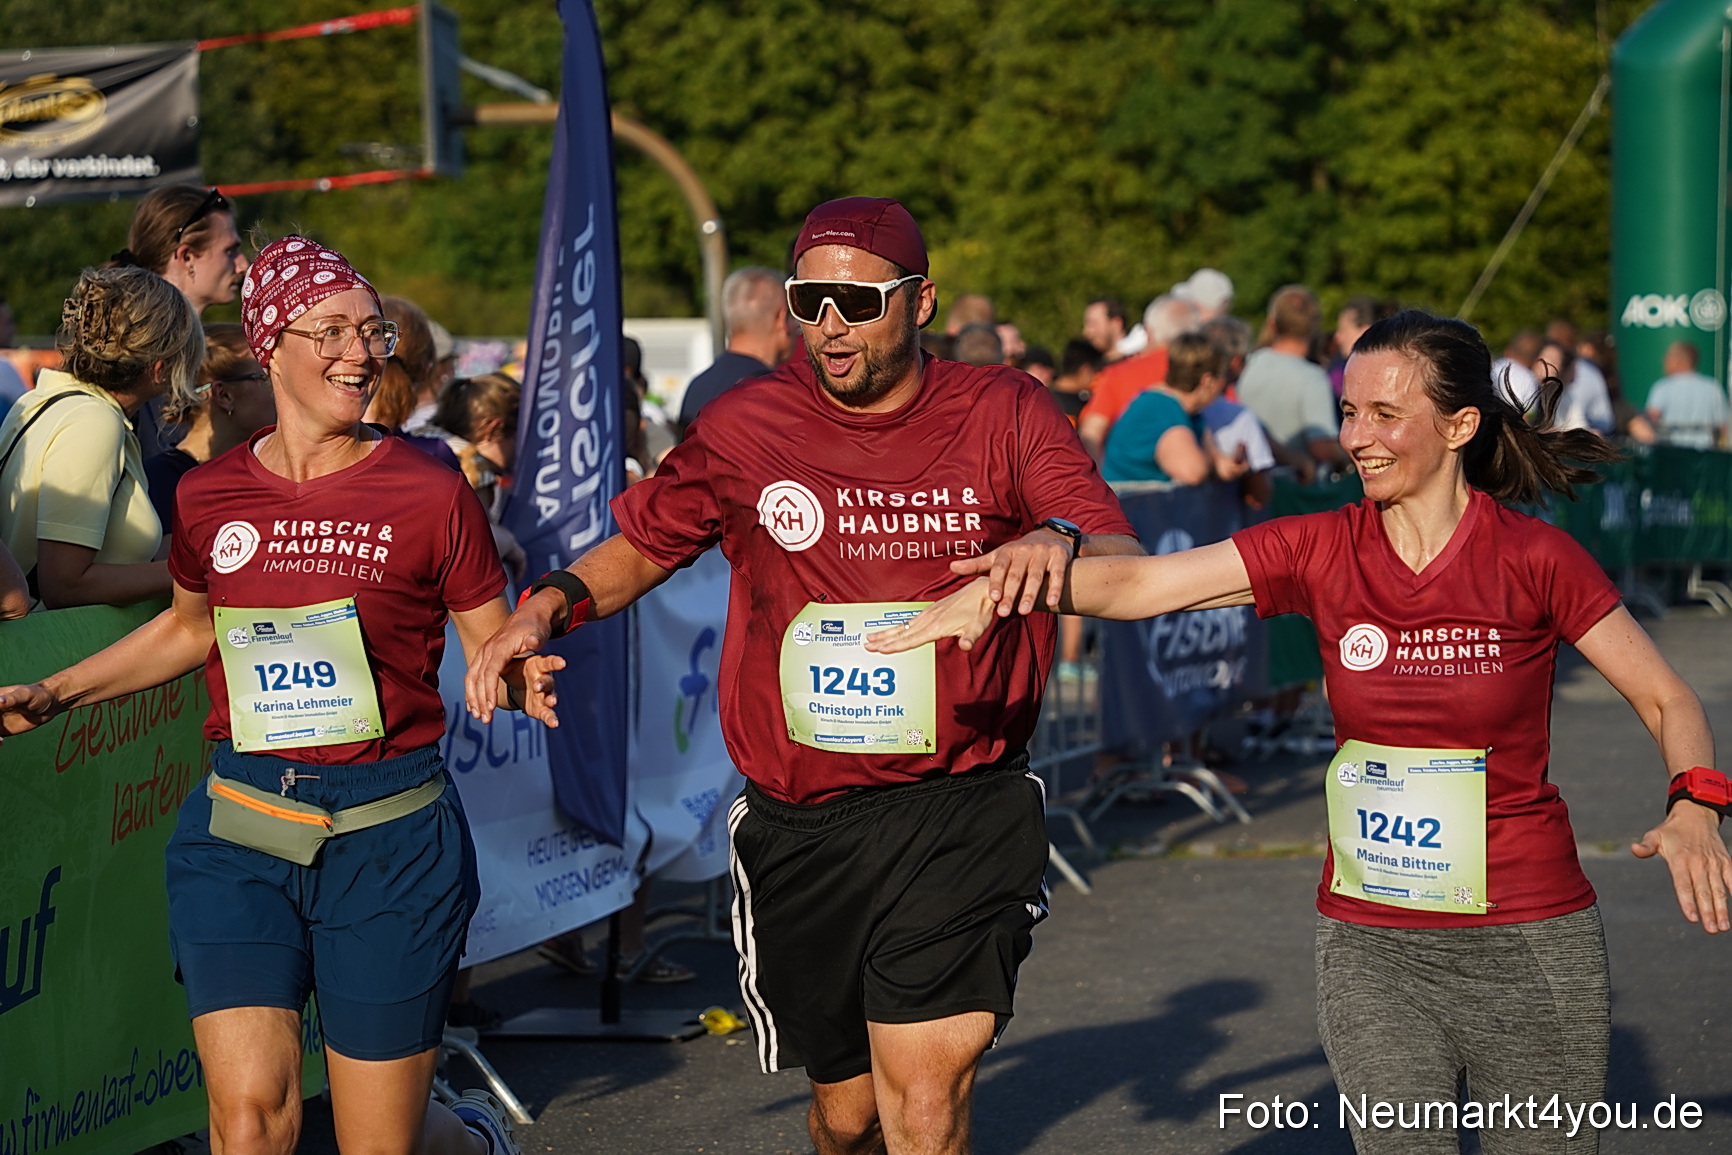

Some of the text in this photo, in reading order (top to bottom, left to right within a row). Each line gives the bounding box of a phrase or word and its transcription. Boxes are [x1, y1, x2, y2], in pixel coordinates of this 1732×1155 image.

[1620, 294, 1690, 328] AOK
[836, 487, 980, 507] KIRSCH &
[273, 519, 393, 543] KIRSCH &
[772, 510, 804, 531] KH
[838, 512, 982, 534] HAUBNER
[267, 538, 389, 564] HAUBNER
[840, 538, 984, 561] IMMOBILIEN
[262, 558, 384, 584] IMMOBILIEN
[251, 632, 293, 643] Firmenlauf
[815, 632, 861, 642] Firmenlauf
[1400, 628, 1501, 643] KIRSCH &
[1349, 642, 1374, 659] KH
[1395, 644, 1501, 660] HAUBNER
[254, 661, 337, 692] 1249
[1393, 661, 1504, 676] IMMOBILIEN
[809, 665, 896, 696] 1243
[254, 695, 353, 713] Karina Lehmeier
[809, 702, 904, 718] Christoph Fink
[1360, 776, 1405, 787] Firmenlauf
[1357, 808, 1442, 849] 1242
[1356, 848, 1451, 872] Marina Bittner
